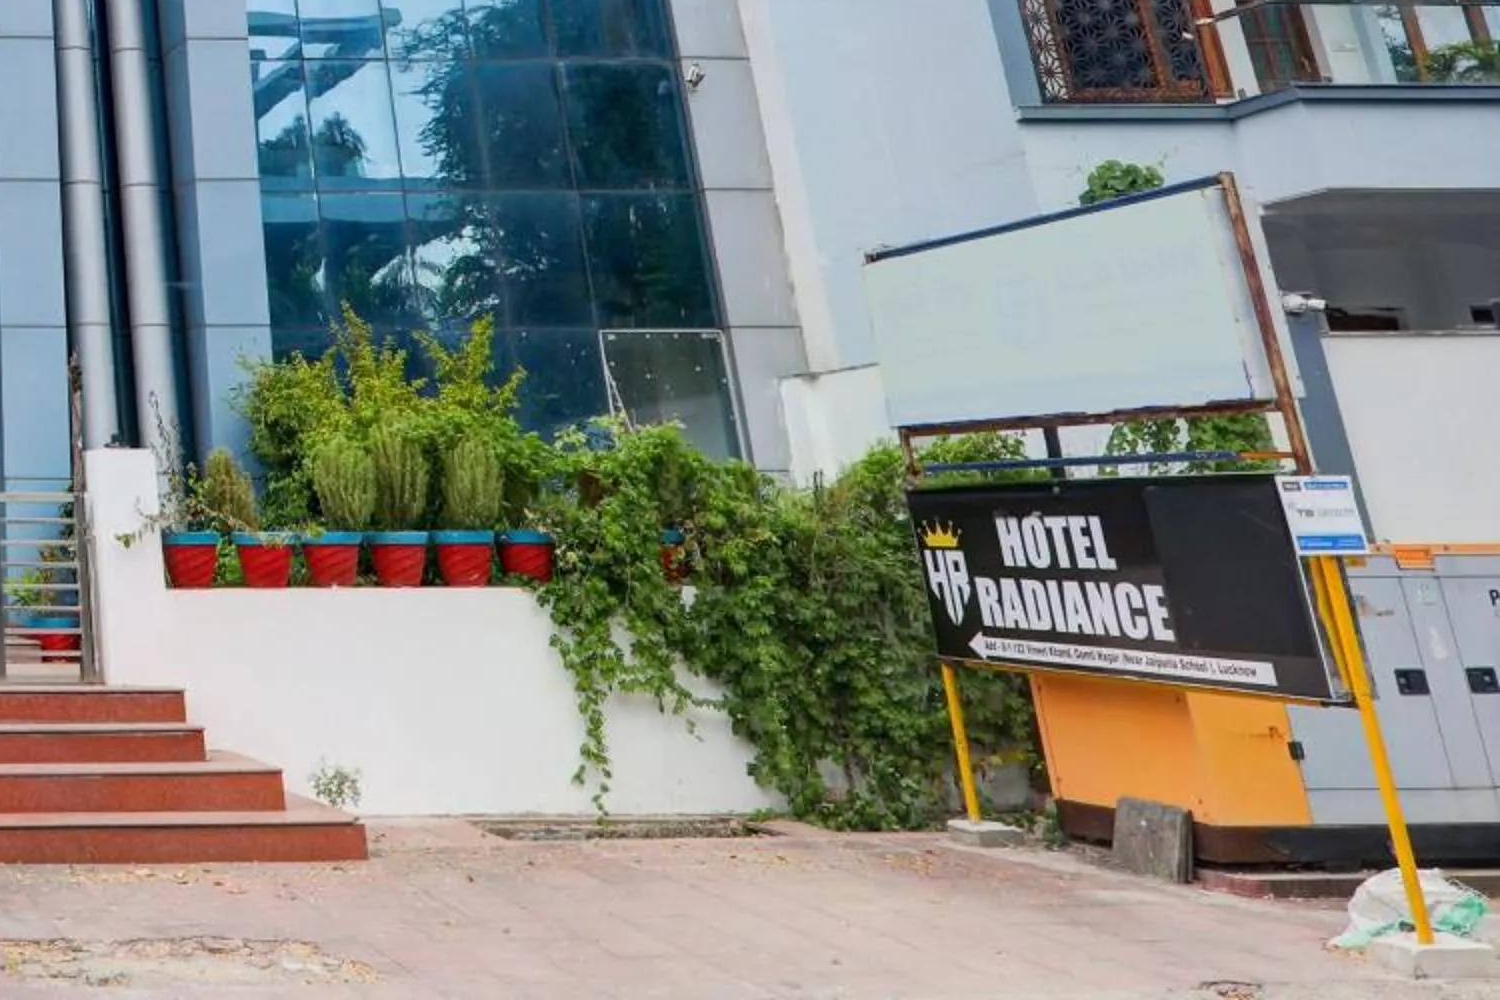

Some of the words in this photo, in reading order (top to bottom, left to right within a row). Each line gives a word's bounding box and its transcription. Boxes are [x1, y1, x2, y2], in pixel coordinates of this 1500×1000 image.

[995, 515, 1118, 571] HOTEL
[974, 577, 1177, 643] RADIANCE
[1218, 664, 1257, 677] Lucknow
